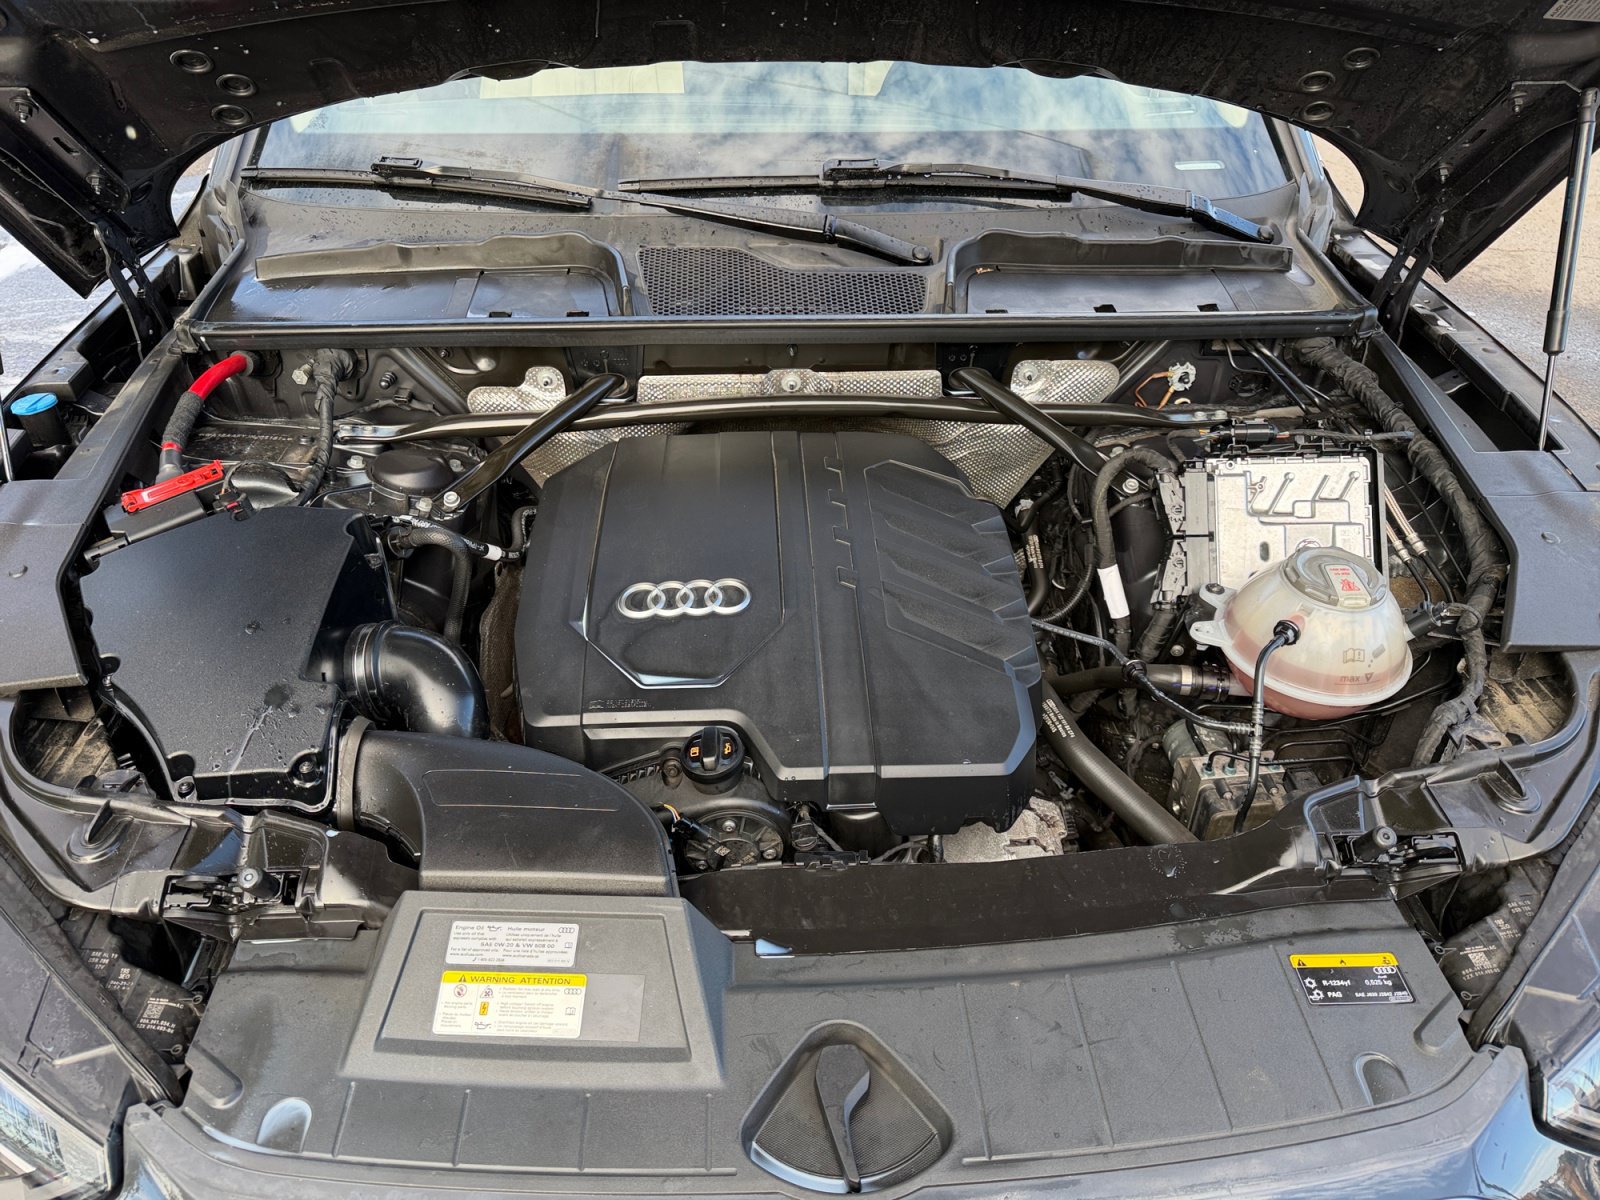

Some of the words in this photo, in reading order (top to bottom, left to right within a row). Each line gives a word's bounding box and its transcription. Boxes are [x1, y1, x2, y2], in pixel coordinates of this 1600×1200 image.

[1339, 675, 1361, 683] max
[470, 976, 515, 984] WARNING
[520, 977, 571, 985] ATTENTION
